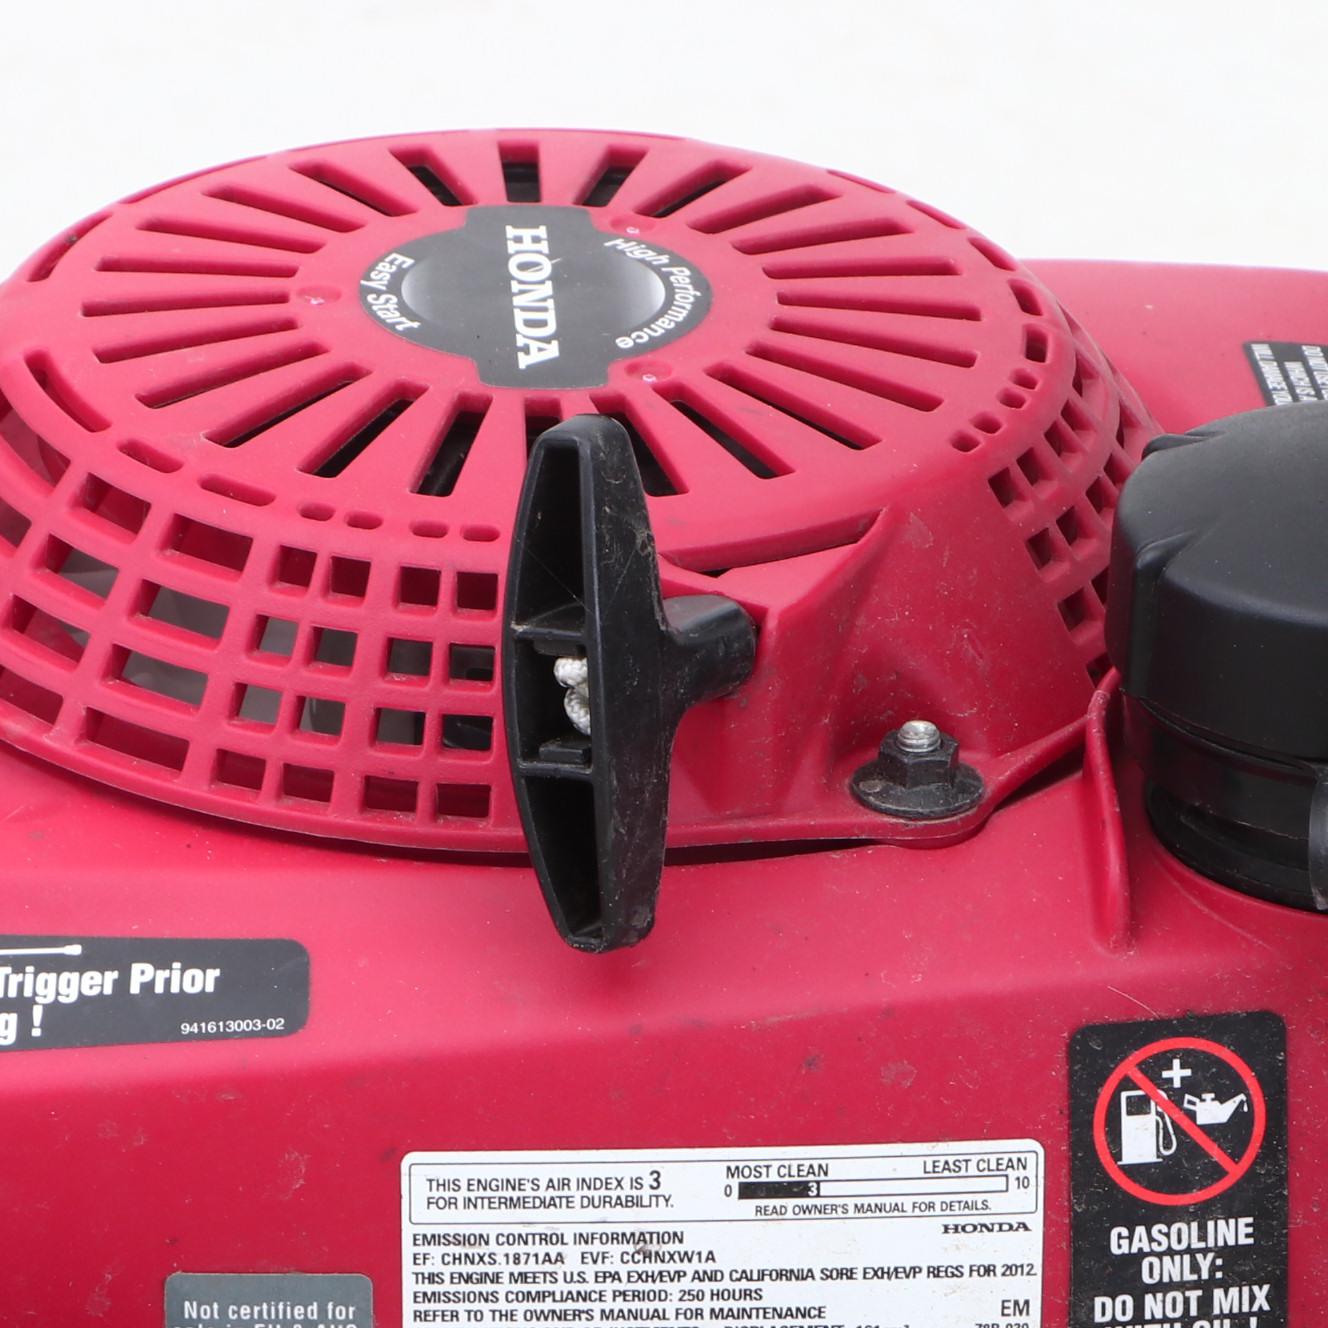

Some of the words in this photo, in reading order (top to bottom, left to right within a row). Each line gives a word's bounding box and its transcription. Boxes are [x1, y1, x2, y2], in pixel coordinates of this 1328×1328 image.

[604, 239, 670, 264] High
[360, 252, 415, 290] Easy
[506, 226, 560, 369] HONDA
[367, 293, 421, 331] Start
[615, 267, 702, 349] Performance
[130, 962, 220, 994] Prior
[181, 1018, 284, 1036] 941613003-02
[727, 1165, 772, 1179] MOST
[777, 1164, 828, 1178] CLEAN
[924, 1159, 971, 1174] LEAST
[977, 1157, 1027, 1172] CLEAN
[427, 1179, 461, 1192] THIS
[467, 1178, 540, 1192] ENGINE'S
[546, 1178, 570, 1191] AIR
[577, 1177, 624, 1190] INDEX
[630, 1177, 643, 1190] IS
[650, 1170, 660, 1190] 3
[427, 1197, 457, 1210] FOR
[464, 1196, 574, 1209] INTERMEDIATE
[581, 1195, 674, 1208] DURABILITY.
[756, 1205, 787, 1216] READ
[793, 1204, 848, 1215] OWNER'S
[854, 1203, 906, 1213] MANUAL
[912, 1202, 935, 1212] FOR
[941, 1200, 991, 1211] DETAILS.
[943, 1222, 1031, 1233] HONDA
[1111, 1217, 1254, 1254] GASOLINE
[413, 1233, 489, 1246] EMISSION
[496, 1233, 568, 1246] CONTROL
[574, 1231, 683, 1246] INFORMATION
[413, 1253, 435, 1265] EF:
[442, 1252, 564, 1265] CHNXS.1871AA
[581, 1252, 614, 1264] EVF:
[621, 1250, 715, 1264] CCHNXW1A
[1142, 1253, 1222, 1284] ONLY:
[414, 1291, 499, 1303] EMISSIONS
[505, 1290, 606, 1303] COMPLIANCE
[613, 1290, 672, 1302] PERIOD:
[679, 1290, 704, 1301] 250
[711, 1288, 762, 1301] HOURS
[1095, 1295, 1138, 1322] DO
[1145, 1290, 1202, 1319] NOT
[1213, 1284, 1270, 1314] MIX
[185, 1301, 219, 1319] Not
[229, 1302, 317, 1320] certified
[328, 1302, 355, 1320] for
[1001, 1300, 1029, 1316] EM
